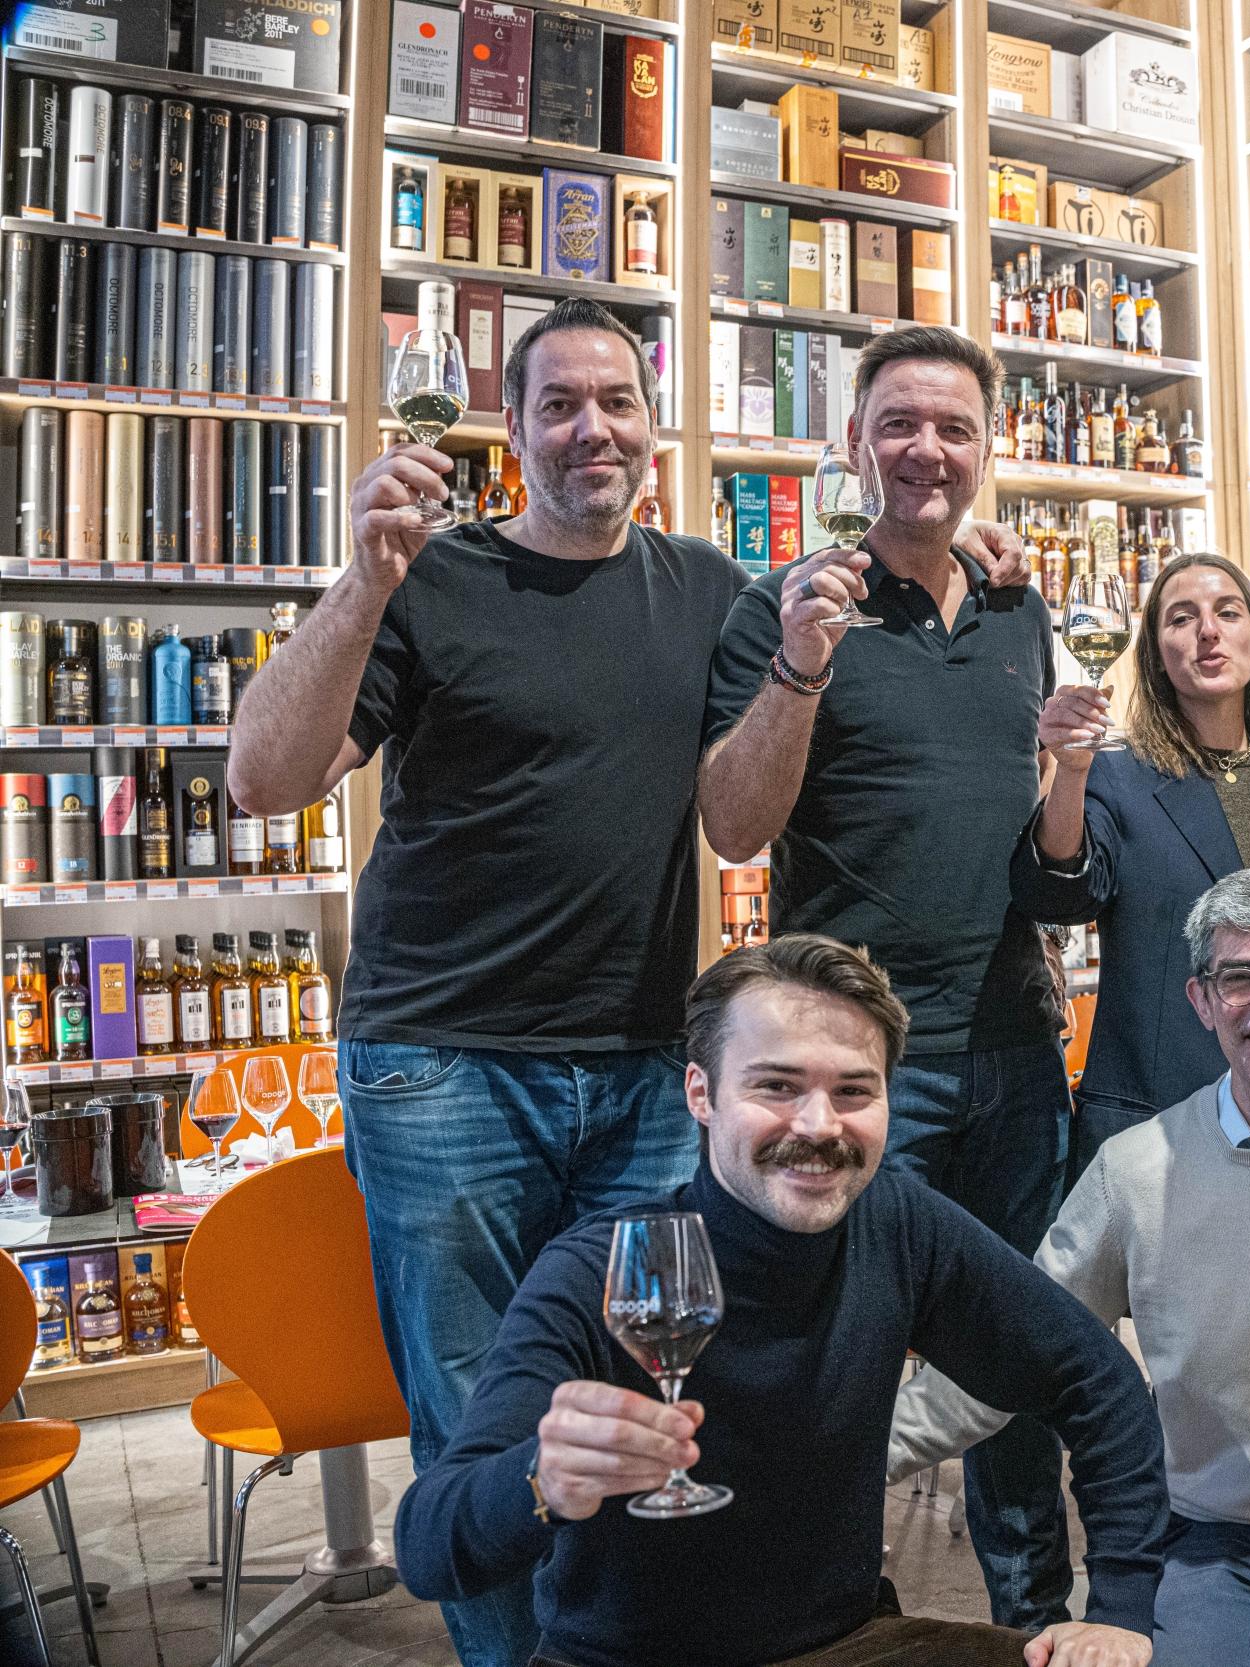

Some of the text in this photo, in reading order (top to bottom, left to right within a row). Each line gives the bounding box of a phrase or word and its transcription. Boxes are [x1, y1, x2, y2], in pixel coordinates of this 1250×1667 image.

[265, 14, 289, 25] BERE
[264, 22, 300, 35] BARLEY
[264, 30, 284, 39] 2011
[398, 42, 449, 57] GLENDRONACH
[1122, 101, 1162, 119] Christian
[43, 97, 56, 149] OCTOMORE
[245, 117, 268, 133] 09.3
[108, 278, 120, 336] OCTOMORE
[153, 282, 165, 340] OCTOMORE
[740, 492, 756, 500] MARS
[106, 644, 122, 654] THE
[105, 652, 142, 663] ORGANIC
